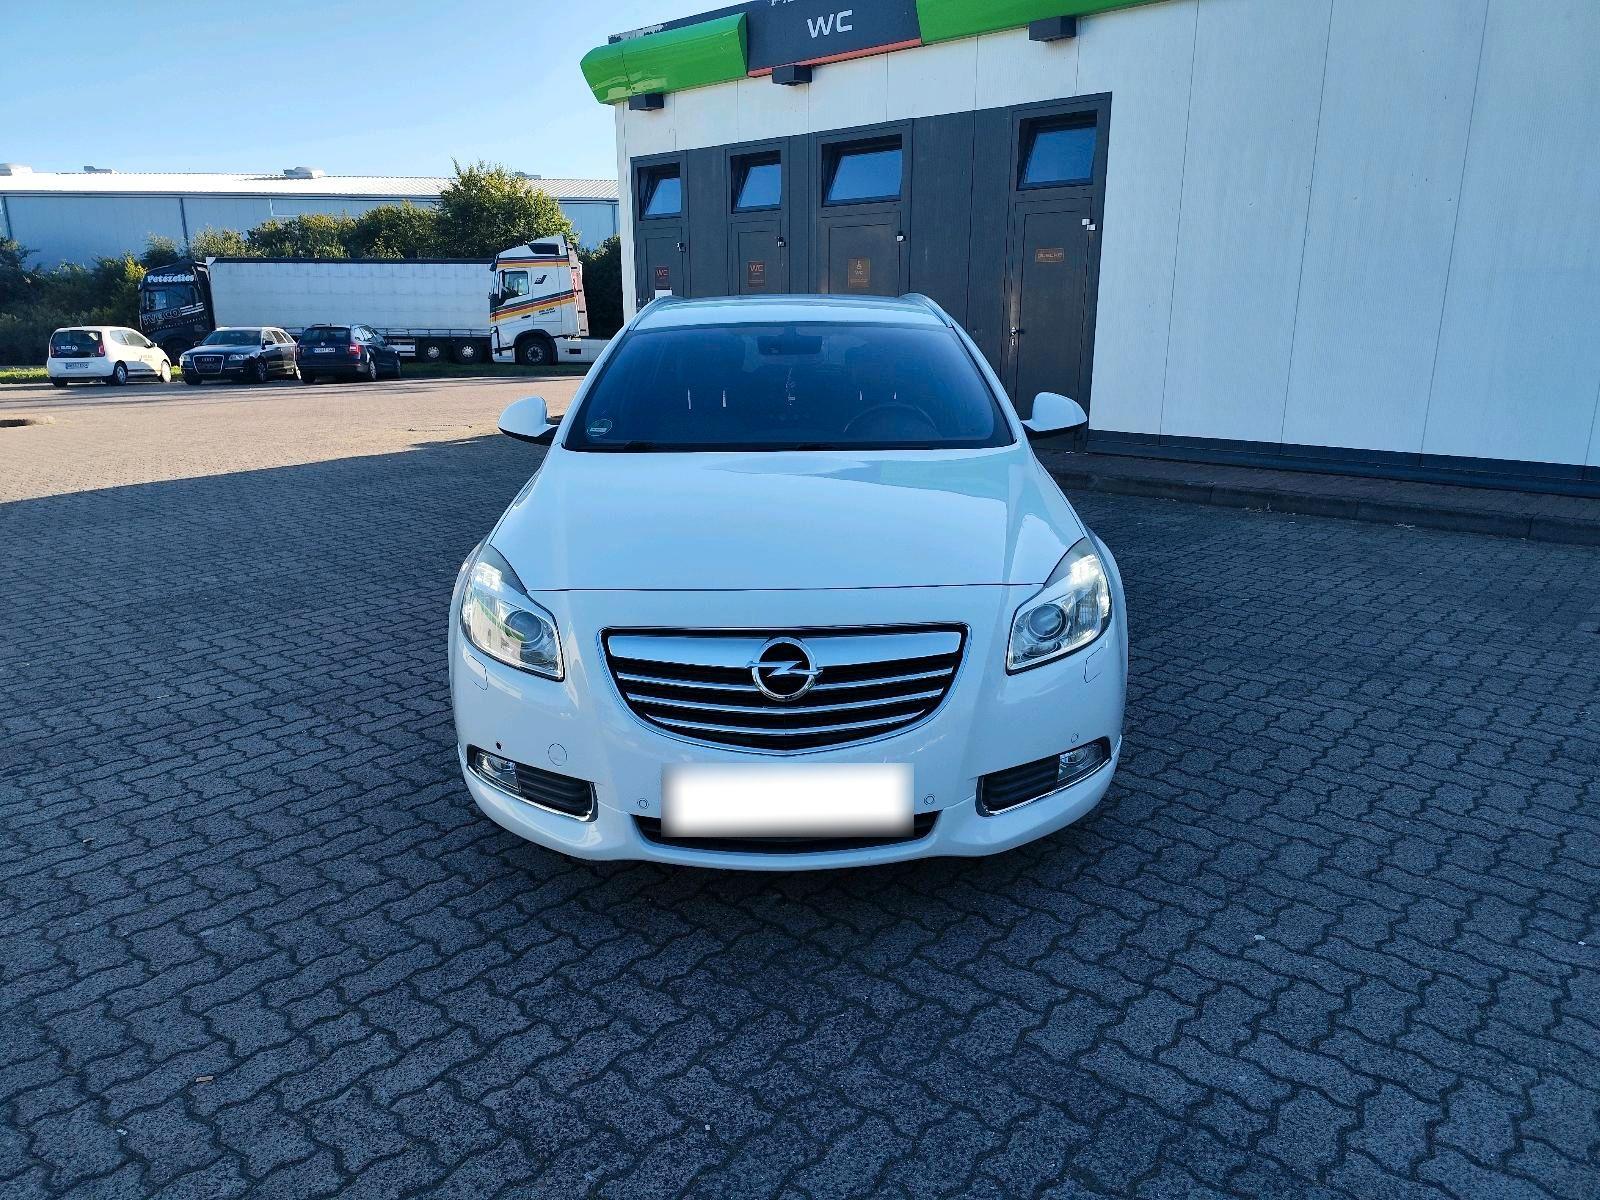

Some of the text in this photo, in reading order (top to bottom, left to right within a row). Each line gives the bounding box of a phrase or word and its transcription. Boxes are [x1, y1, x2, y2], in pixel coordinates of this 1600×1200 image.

[806, 9, 853, 38] WC
[750, 264, 764, 272] WC
[656, 269, 669, 277] WC
